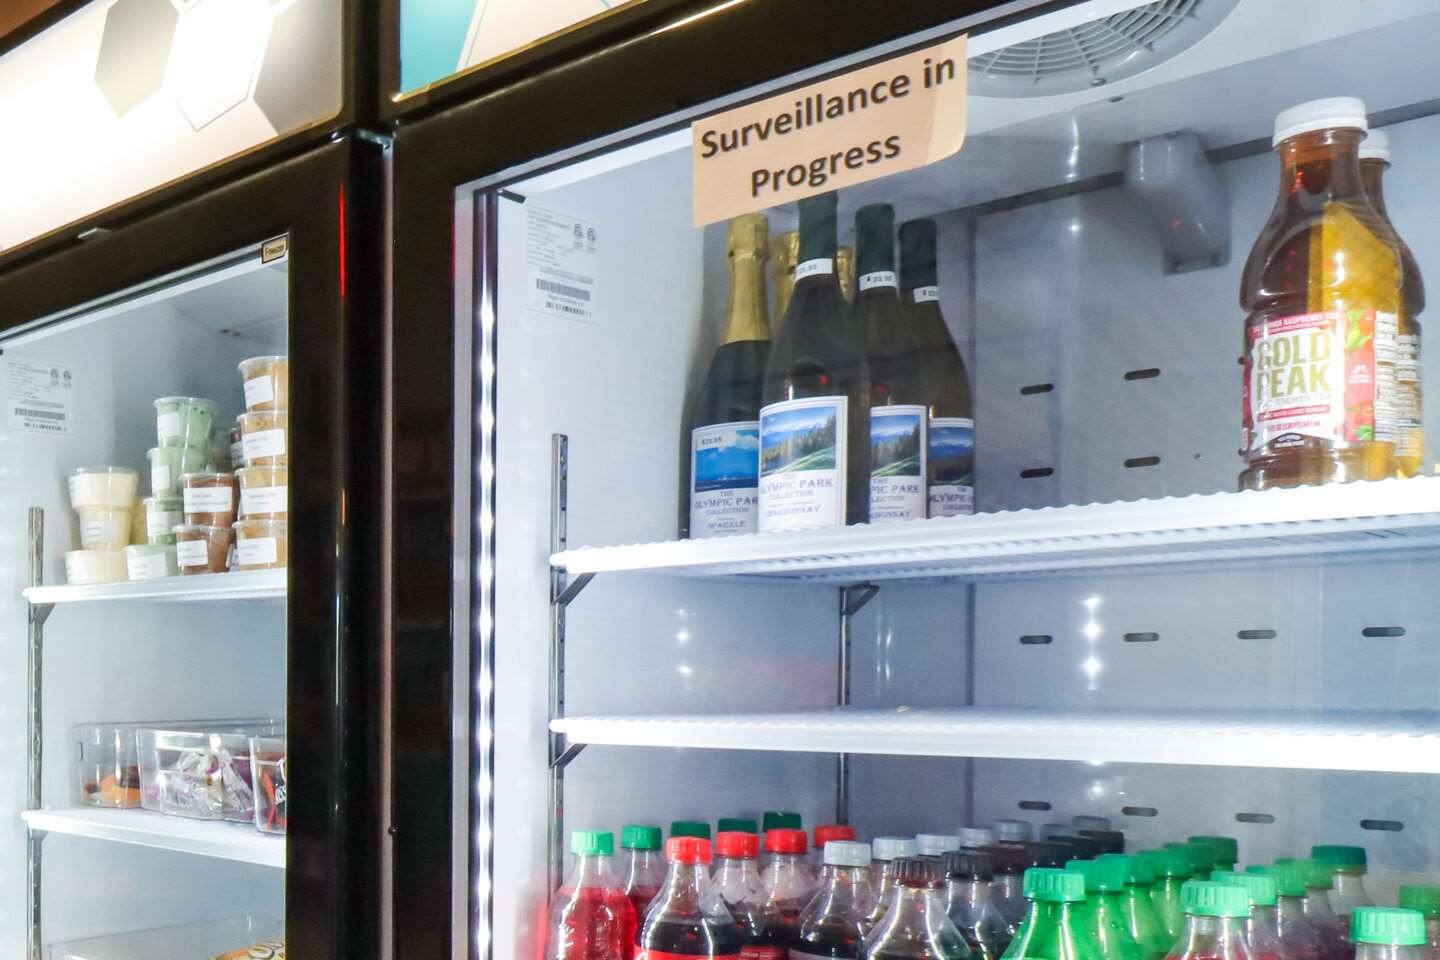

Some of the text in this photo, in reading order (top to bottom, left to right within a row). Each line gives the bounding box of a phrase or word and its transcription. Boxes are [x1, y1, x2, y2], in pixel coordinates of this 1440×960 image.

[700, 57, 955, 159] Surveillance in
[751, 135, 901, 198] Progress
[1256, 332, 1331, 371] GOLD
[1256, 363, 1330, 401] PEAK
[799, 478, 833, 489] PARK
[891, 485, 920, 494] PARK
[695, 496, 759, 510] OLYMPIC PAR
